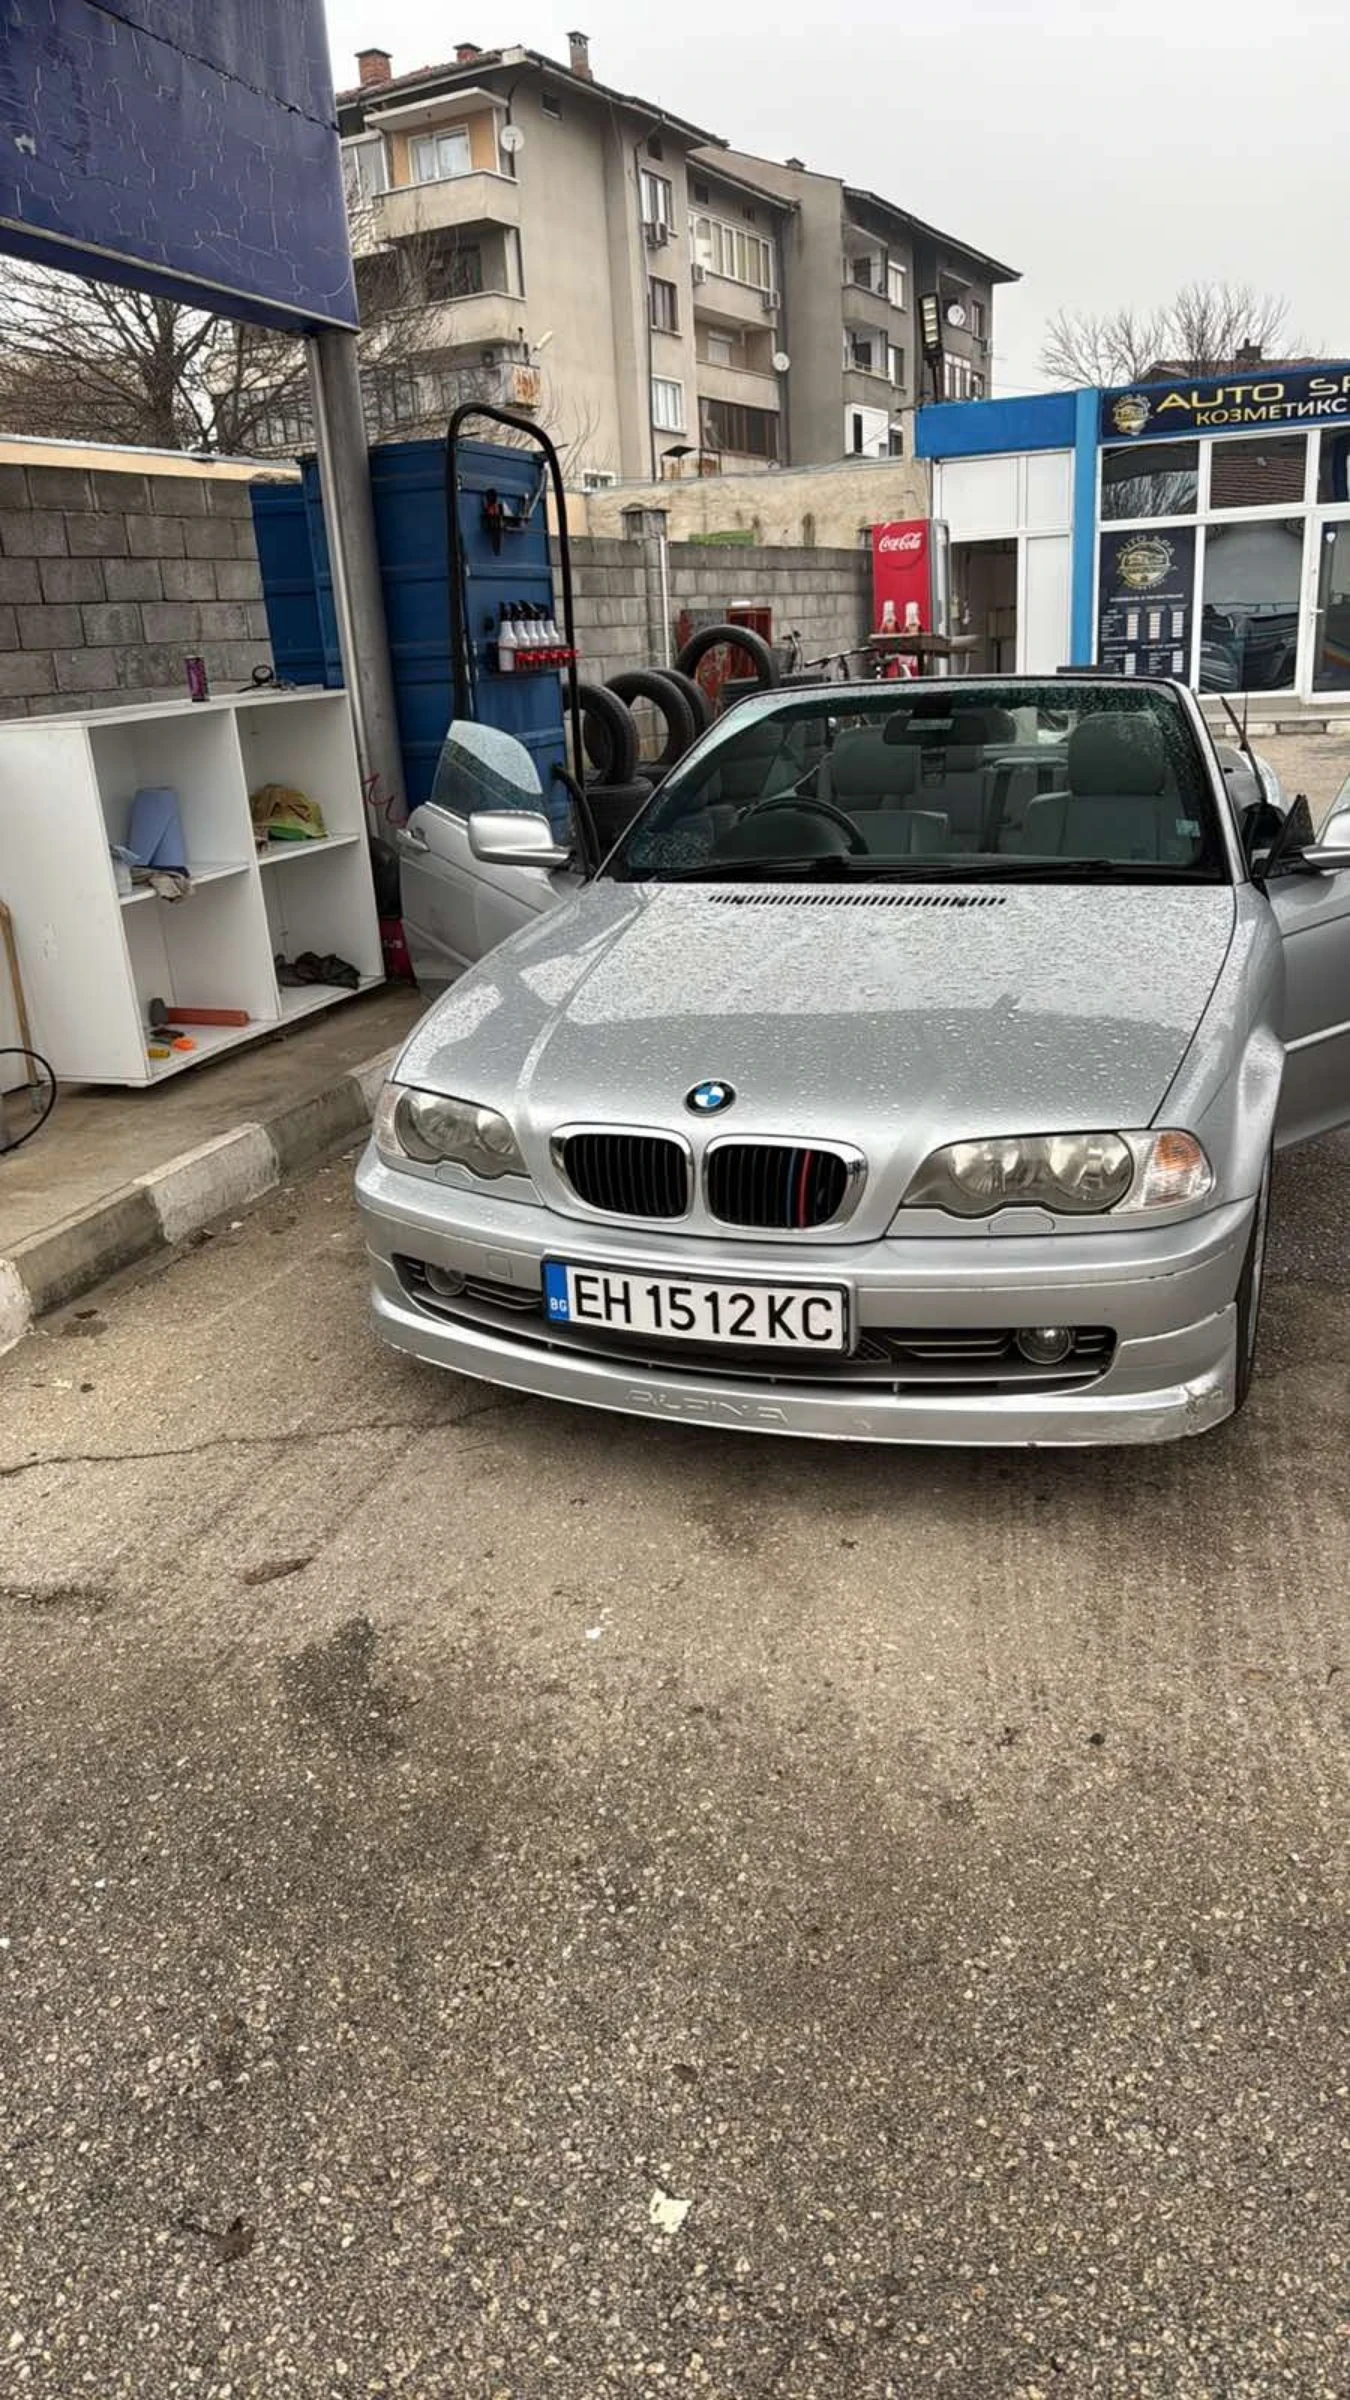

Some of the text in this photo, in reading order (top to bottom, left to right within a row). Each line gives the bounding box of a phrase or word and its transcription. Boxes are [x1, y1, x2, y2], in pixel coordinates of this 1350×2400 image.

[1156, 383, 1285, 413] AUTO
[1196, 397, 1348, 427] КОЗМЕТИКС
[549, 1297, 568, 1313] BG
